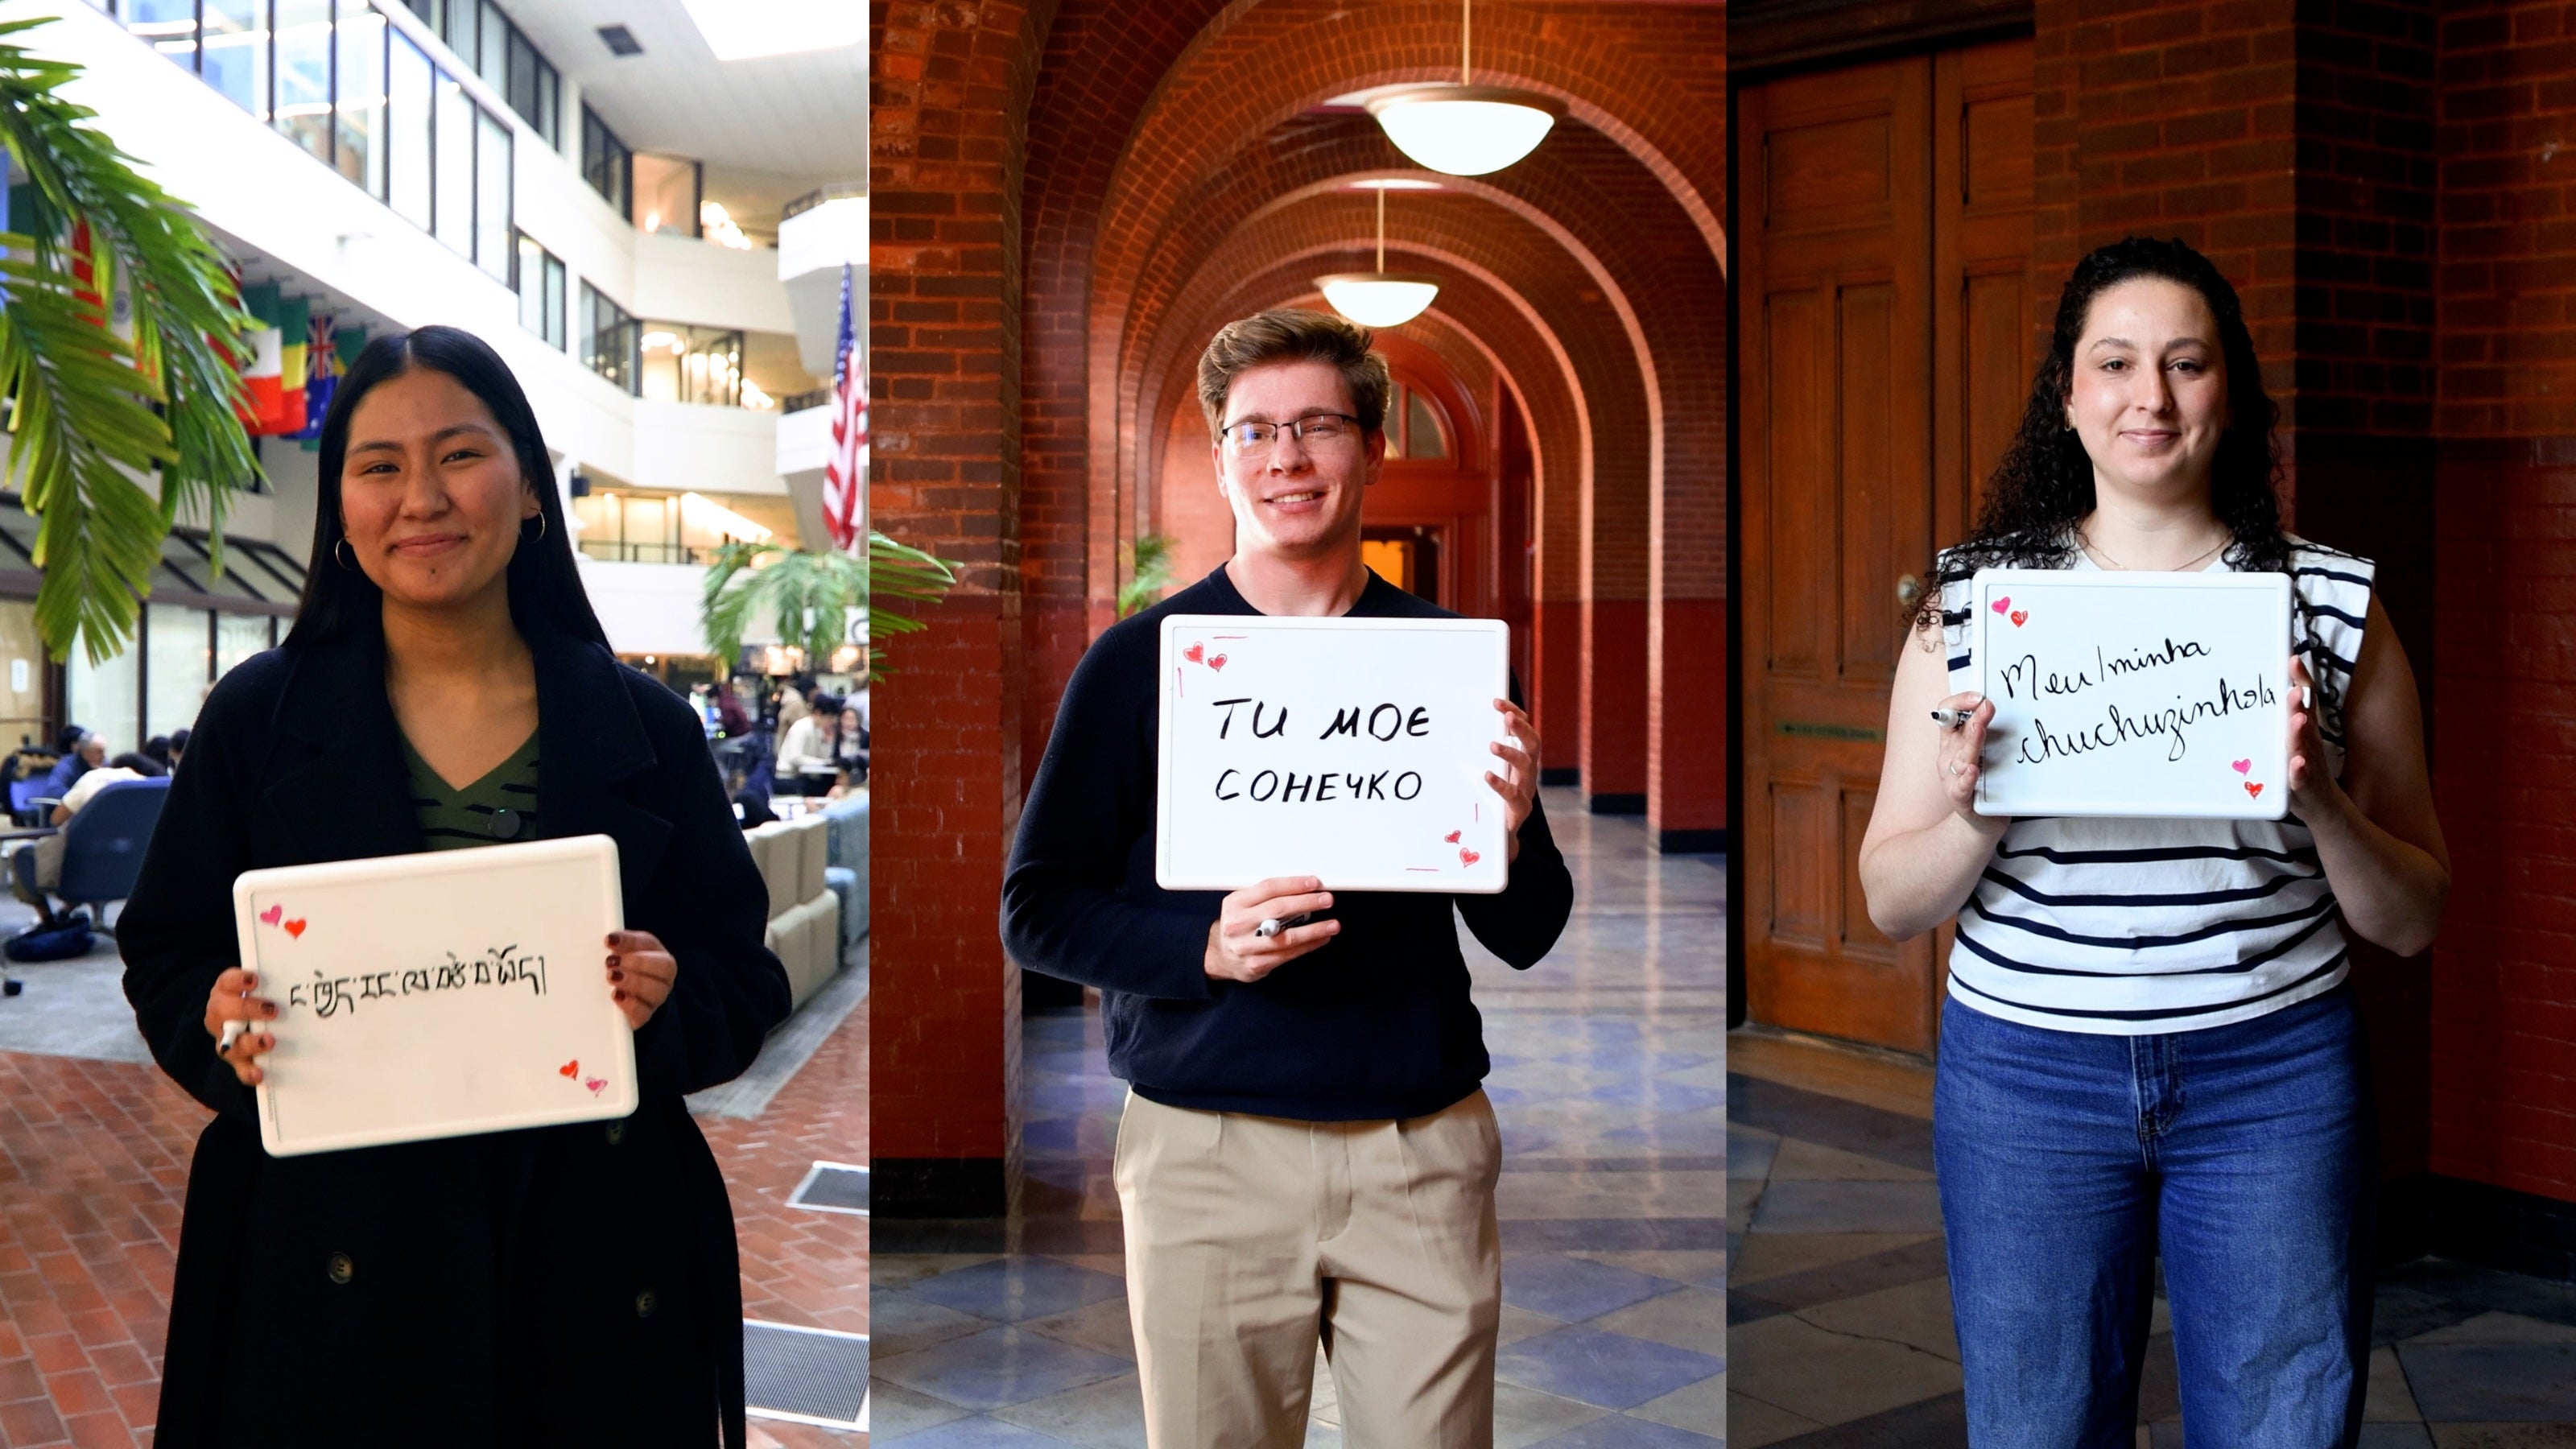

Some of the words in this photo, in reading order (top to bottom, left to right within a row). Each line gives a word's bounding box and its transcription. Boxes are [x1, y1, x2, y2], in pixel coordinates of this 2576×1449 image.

[1212, 697, 1288, 740] ТИ
[1319, 702, 1430, 742] МОЄ
[1214, 768, 1423, 803] СОНЕЧКО
